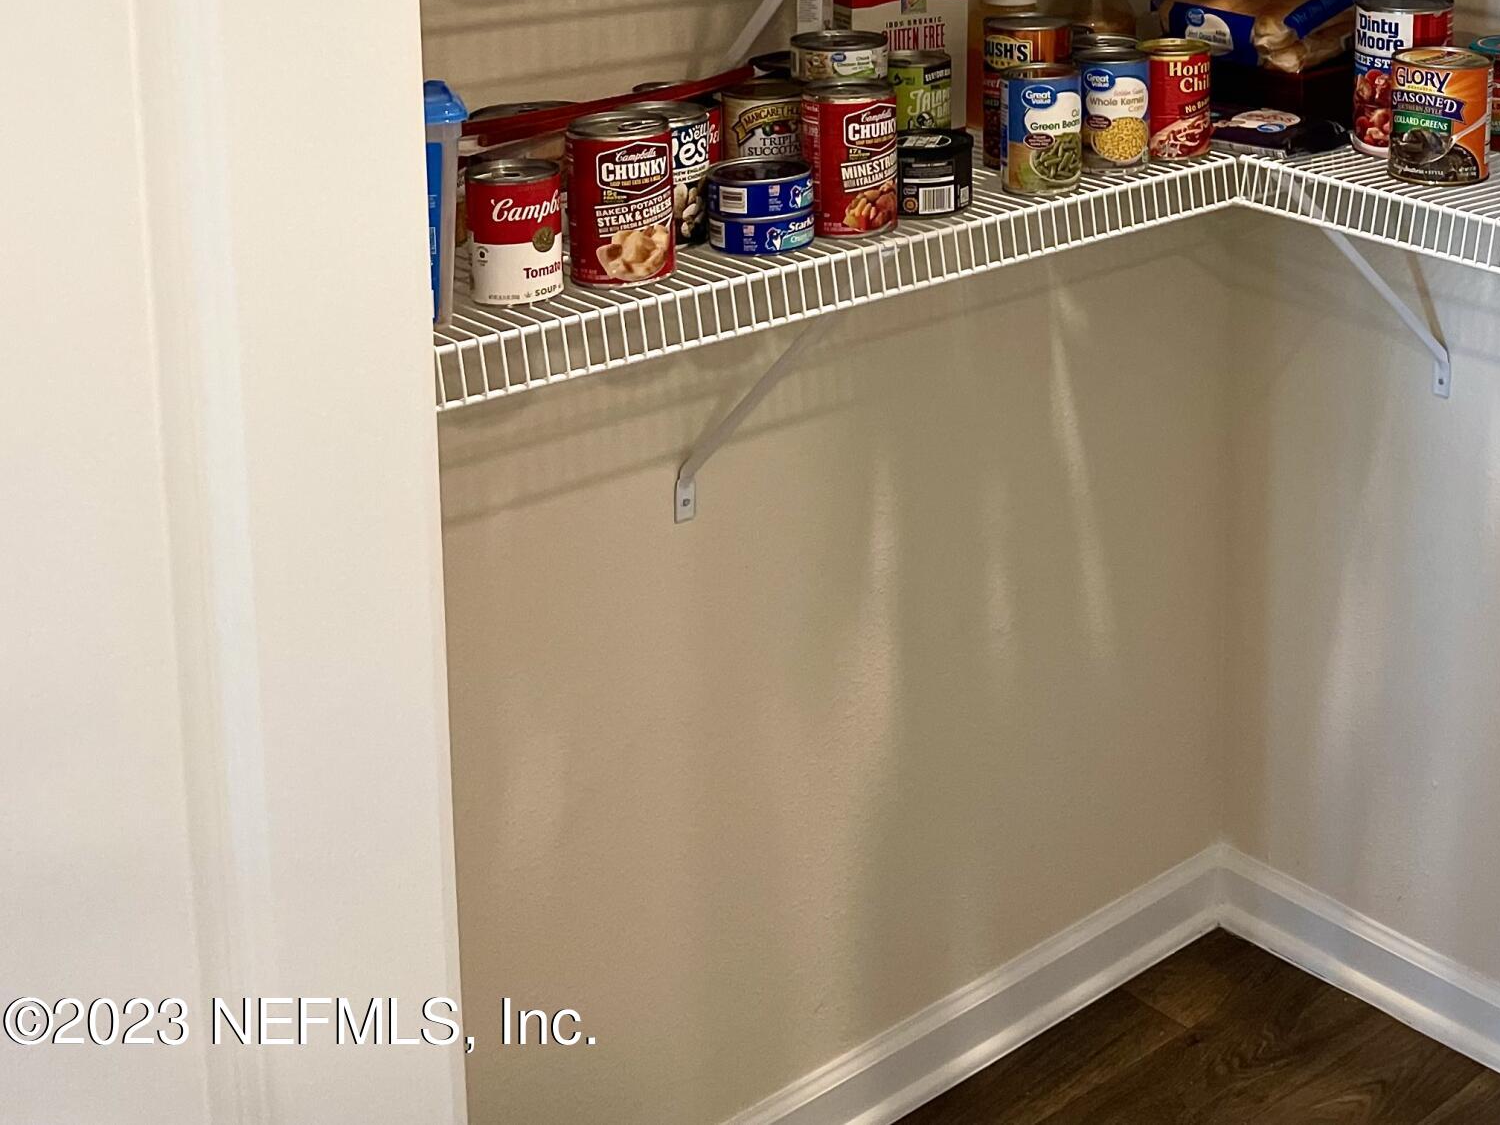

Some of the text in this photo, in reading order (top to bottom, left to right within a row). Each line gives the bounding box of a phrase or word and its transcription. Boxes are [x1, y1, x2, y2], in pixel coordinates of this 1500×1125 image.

[886, 15, 942, 28] 100% ORGANIC
[1358, 13, 1400, 39] Dinty
[924, 23, 946, 51] FREE
[1356, 29, 1405, 52] Moore
[1086, 73, 1109, 84] Great
[1396, 66, 1453, 94] GLORY
[1026, 91, 1051, 99] Great
[1032, 97, 1052, 105] Value
[1090, 95, 1144, 107] Whole Kernel
[1392, 91, 1457, 113] SEASONED
[1185, 104, 1197, 114] No
[1424, 106, 1442, 115] STYLE
[1030, 121, 1060, 131] Green
[1394, 115, 1448, 131] COLLARD GREENS
[602, 155, 666, 183] CHUNKY
[855, 175, 884, 187] ITALIAN
[596, 207, 628, 217] BAKED
[630, 195, 662, 212] POTATO
[597, 213, 634, 227] STEAK
[635, 210, 642, 221] &
[642, 197, 672, 217] CHEESE
[534, 285, 557, 297] SOUP
